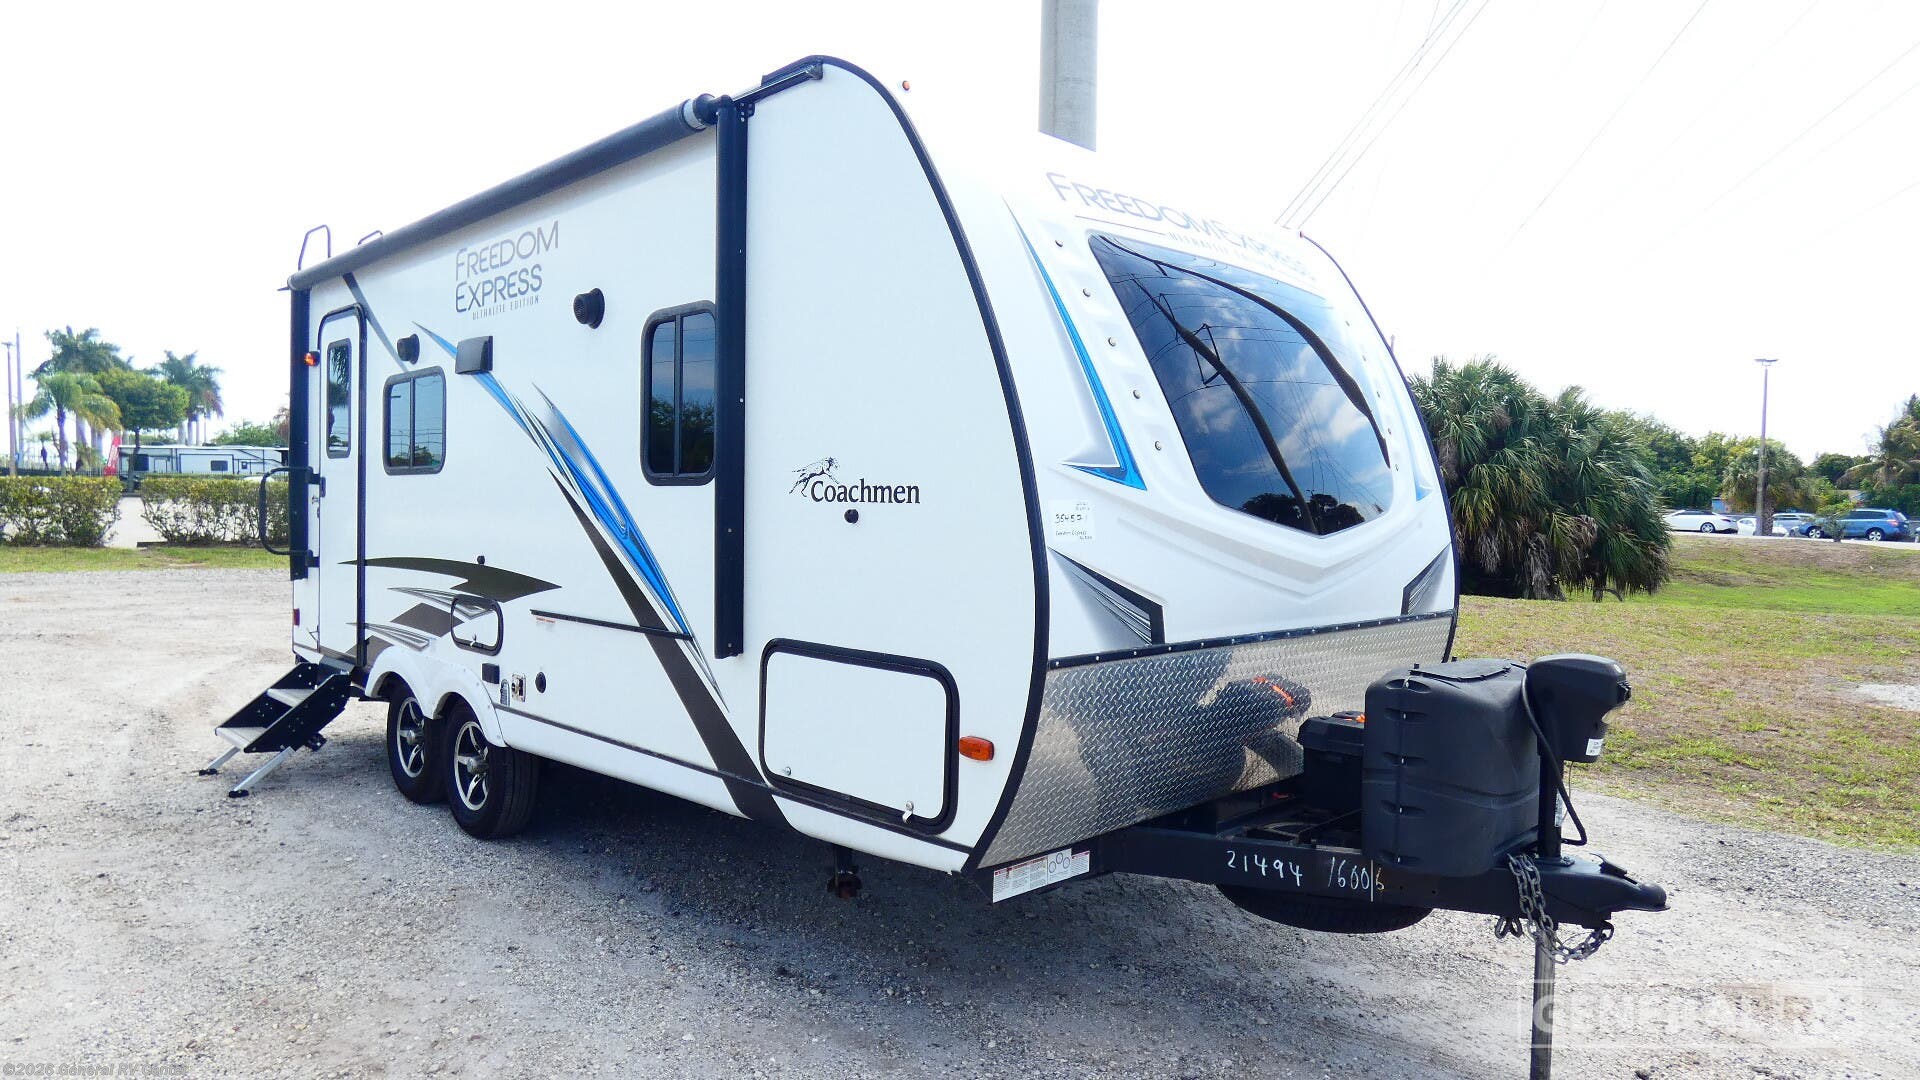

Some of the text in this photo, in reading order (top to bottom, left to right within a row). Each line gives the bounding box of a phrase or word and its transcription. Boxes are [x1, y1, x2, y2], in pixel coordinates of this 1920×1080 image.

[456, 220, 558, 281] FREEDOM
[456, 264, 543, 313] EXPRESS
[810, 477, 920, 504] Coachmen
[1227, 850, 1302, 887] 21494
